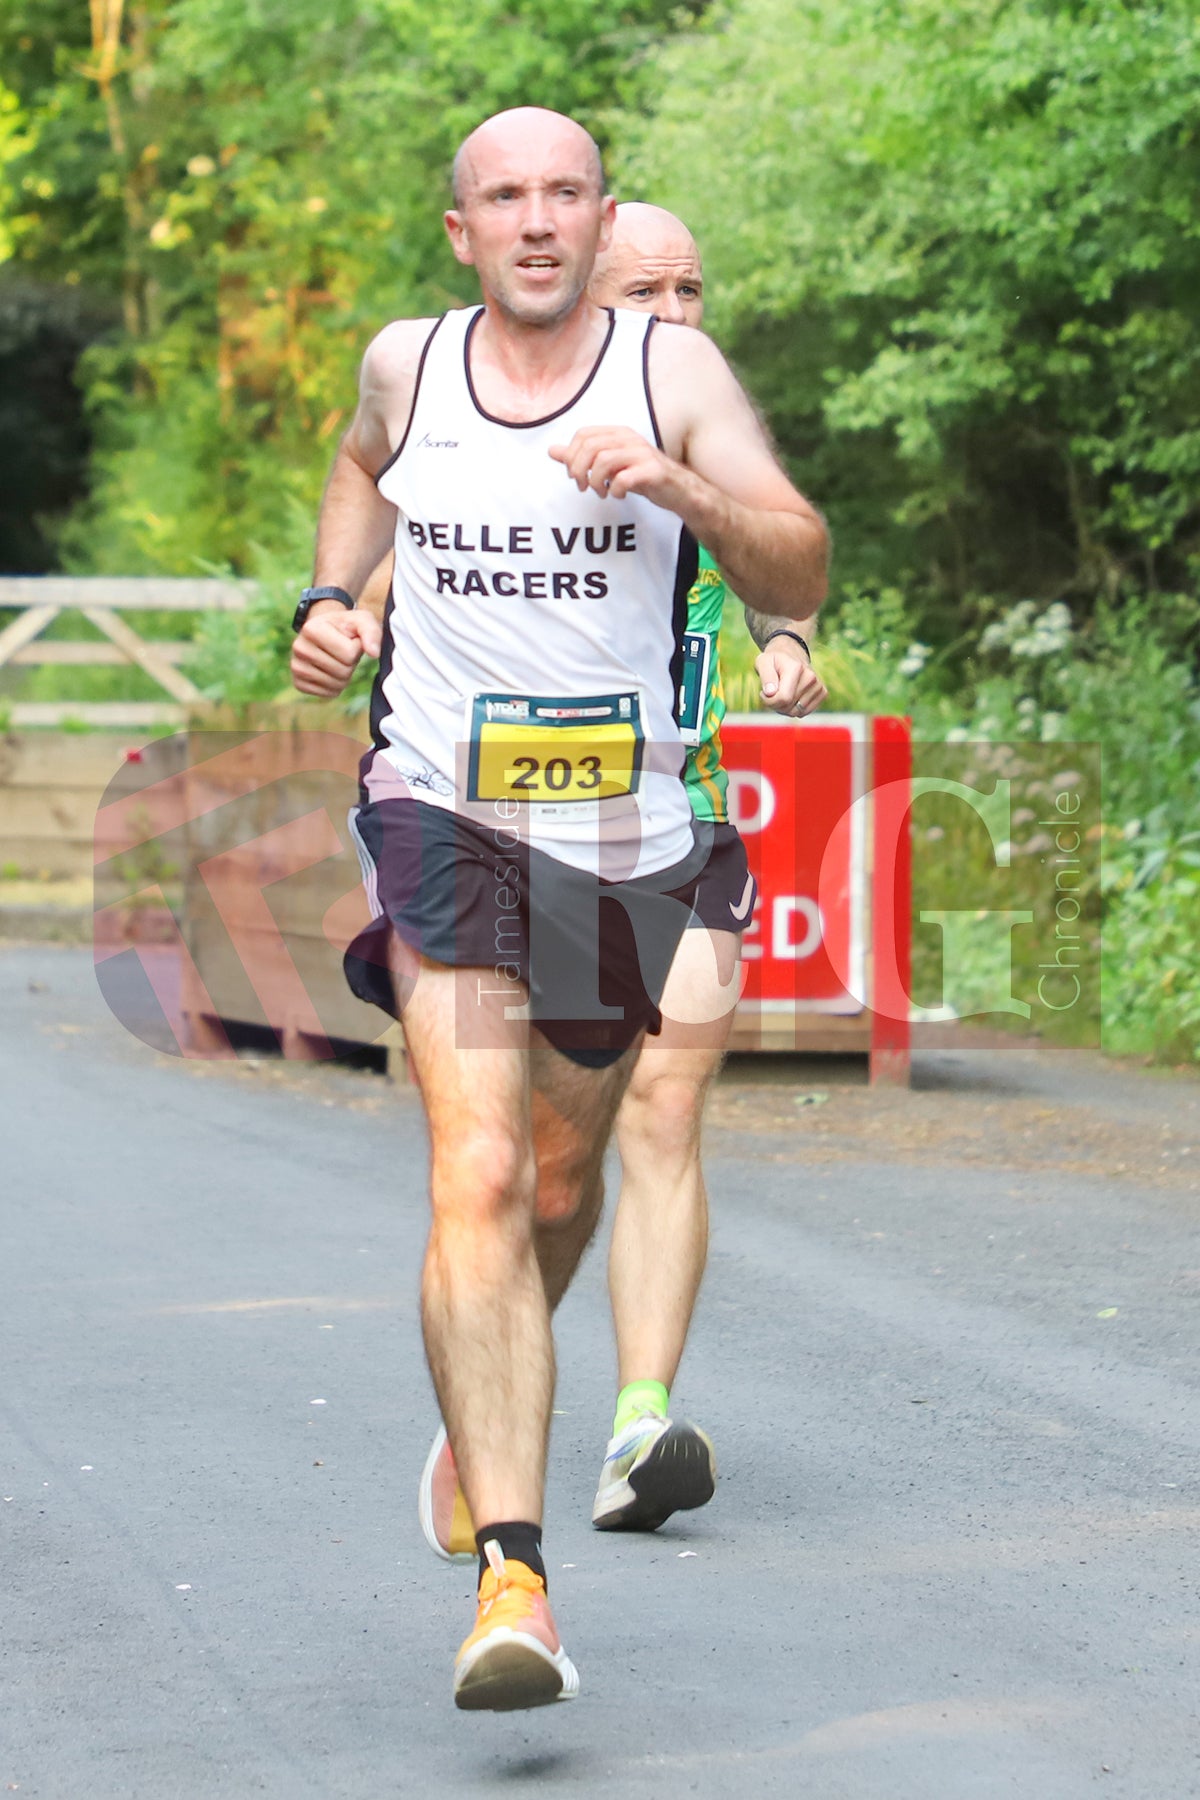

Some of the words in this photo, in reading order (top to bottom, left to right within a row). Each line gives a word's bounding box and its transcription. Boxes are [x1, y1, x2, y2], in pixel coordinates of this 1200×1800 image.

[407, 520, 533, 554] BELLE
[551, 522, 637, 555] VUE
[435, 567, 609, 600] RACERS
[510, 756, 603, 791] 203
